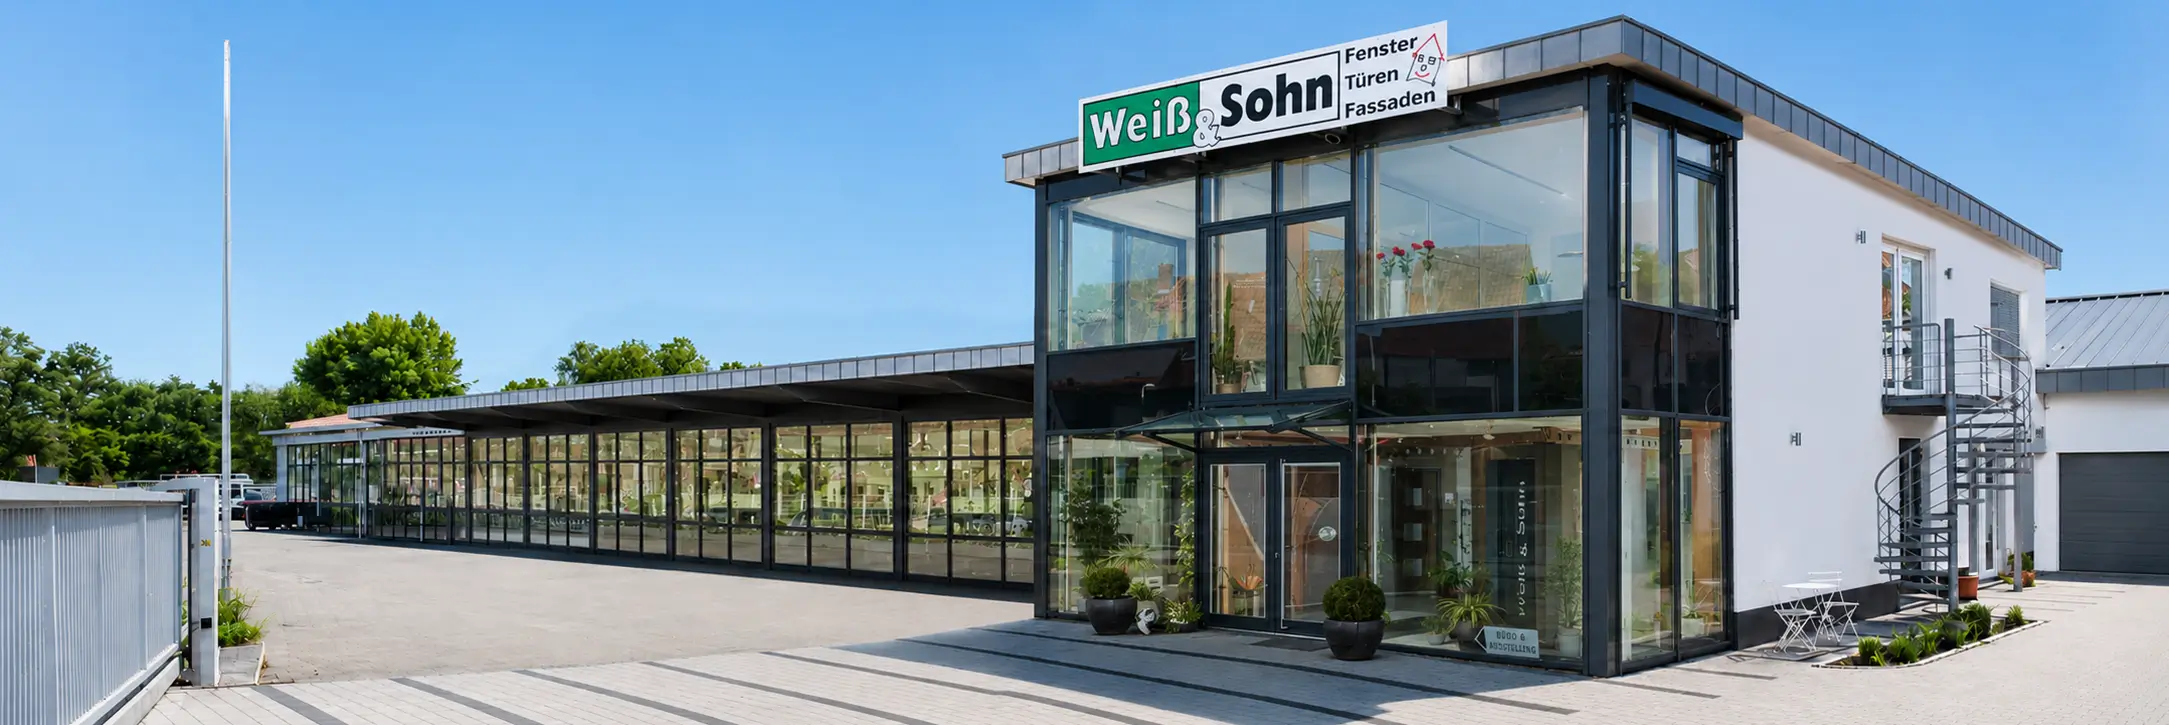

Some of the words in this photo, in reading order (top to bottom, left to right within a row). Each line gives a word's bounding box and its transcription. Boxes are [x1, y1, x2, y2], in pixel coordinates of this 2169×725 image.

[1345, 35, 1418, 64] Fenster
[1345, 68, 1399, 90] Türen
[1089, 96, 1191, 149] Weiß
[1192, 109, 1221, 148] &
[1220, 72, 1333, 127] Sohn
[1345, 88, 1436, 119] Fassaden
